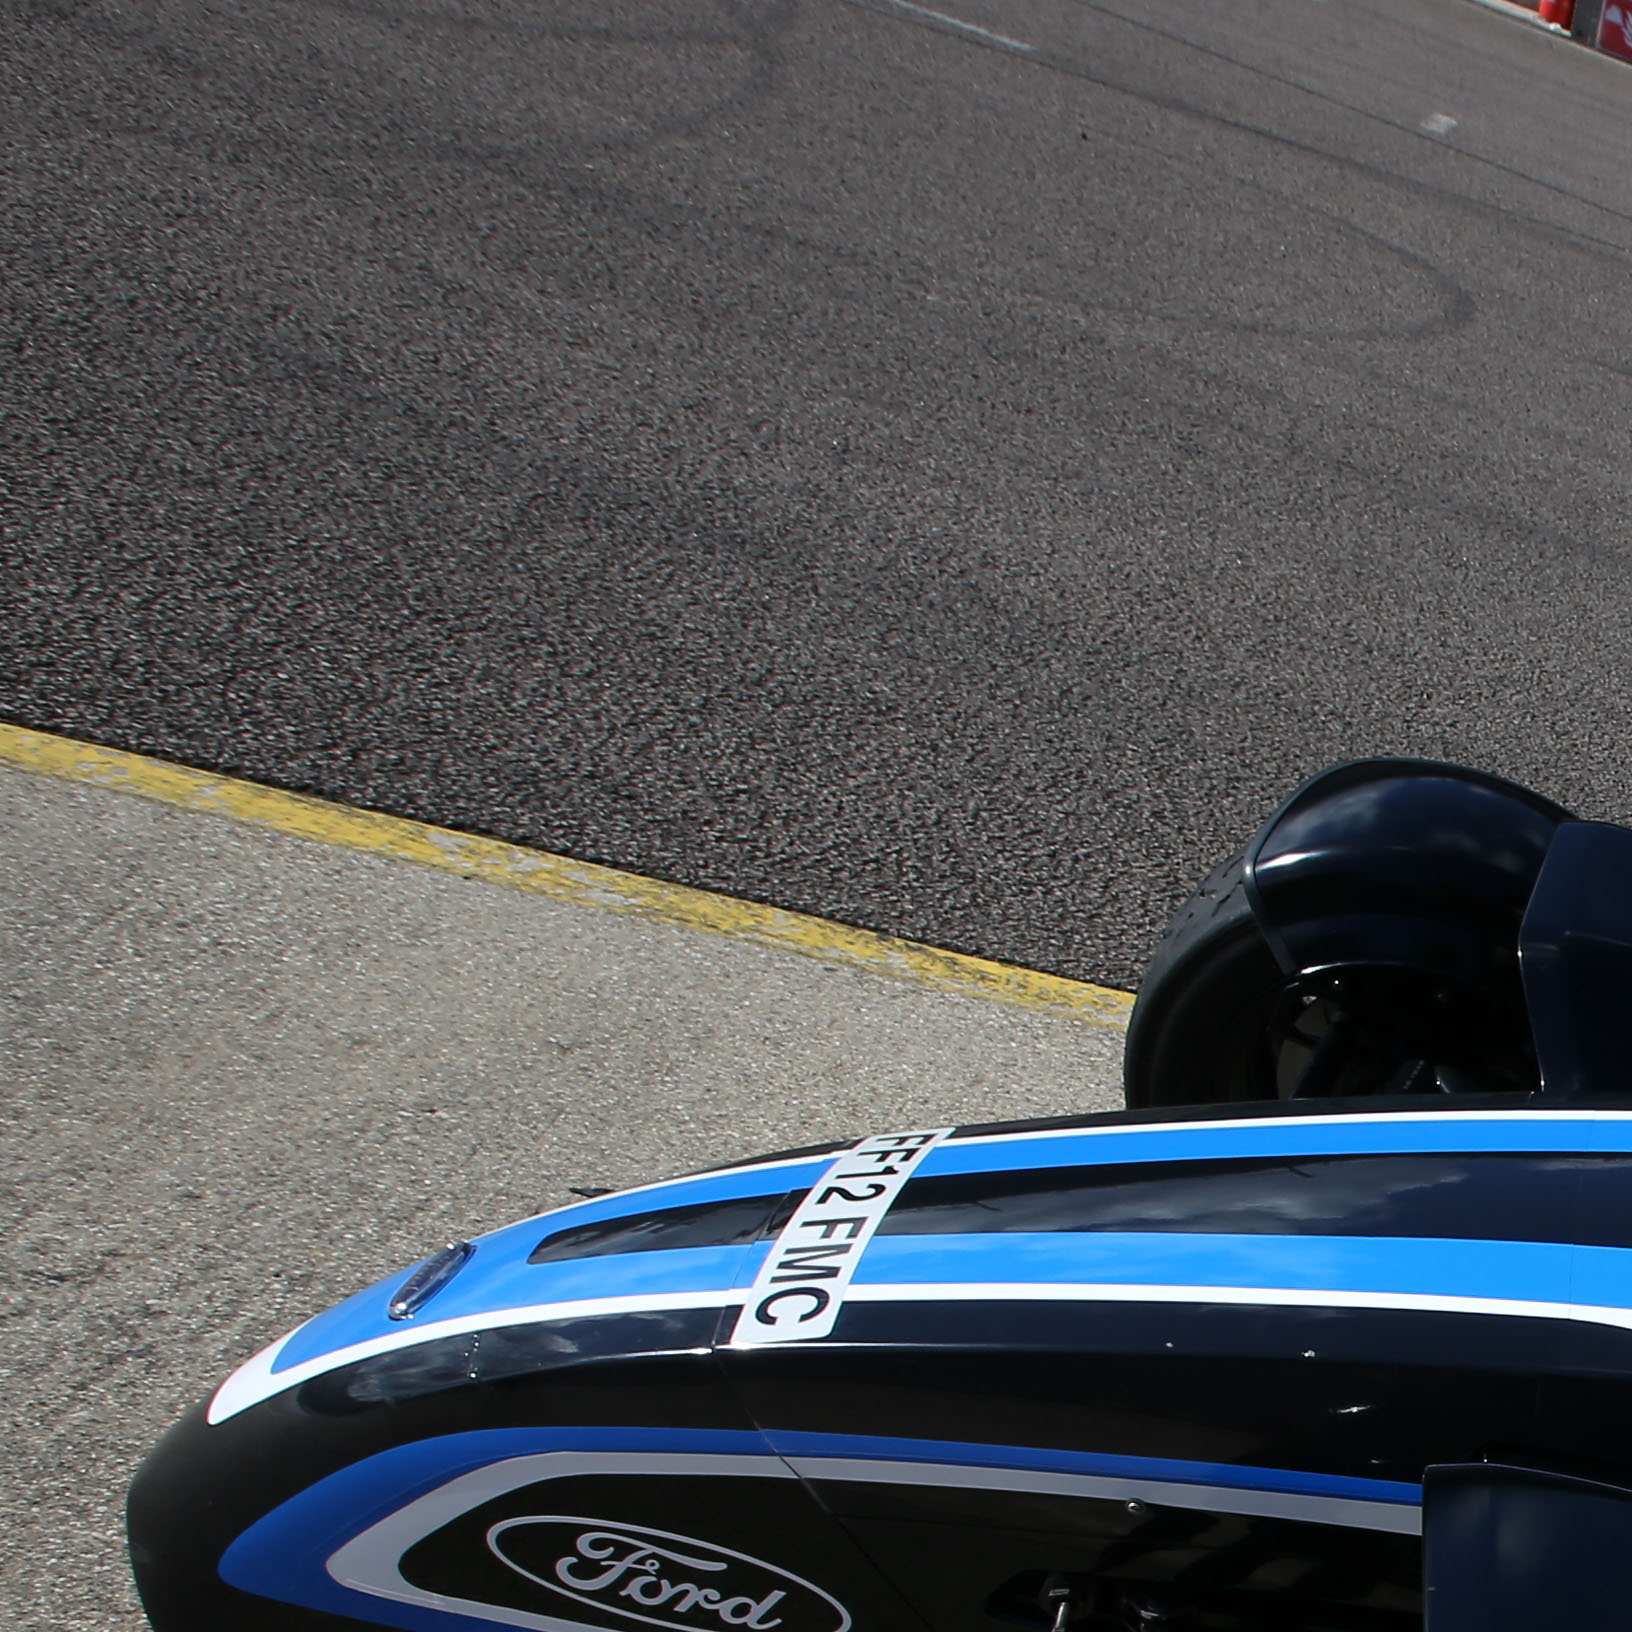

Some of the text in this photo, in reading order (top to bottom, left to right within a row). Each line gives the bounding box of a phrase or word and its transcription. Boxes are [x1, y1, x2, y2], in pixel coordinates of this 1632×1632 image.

[755, 1133, 939, 1326] FF12 FMC
[555, 1531, 787, 1630] Ford
